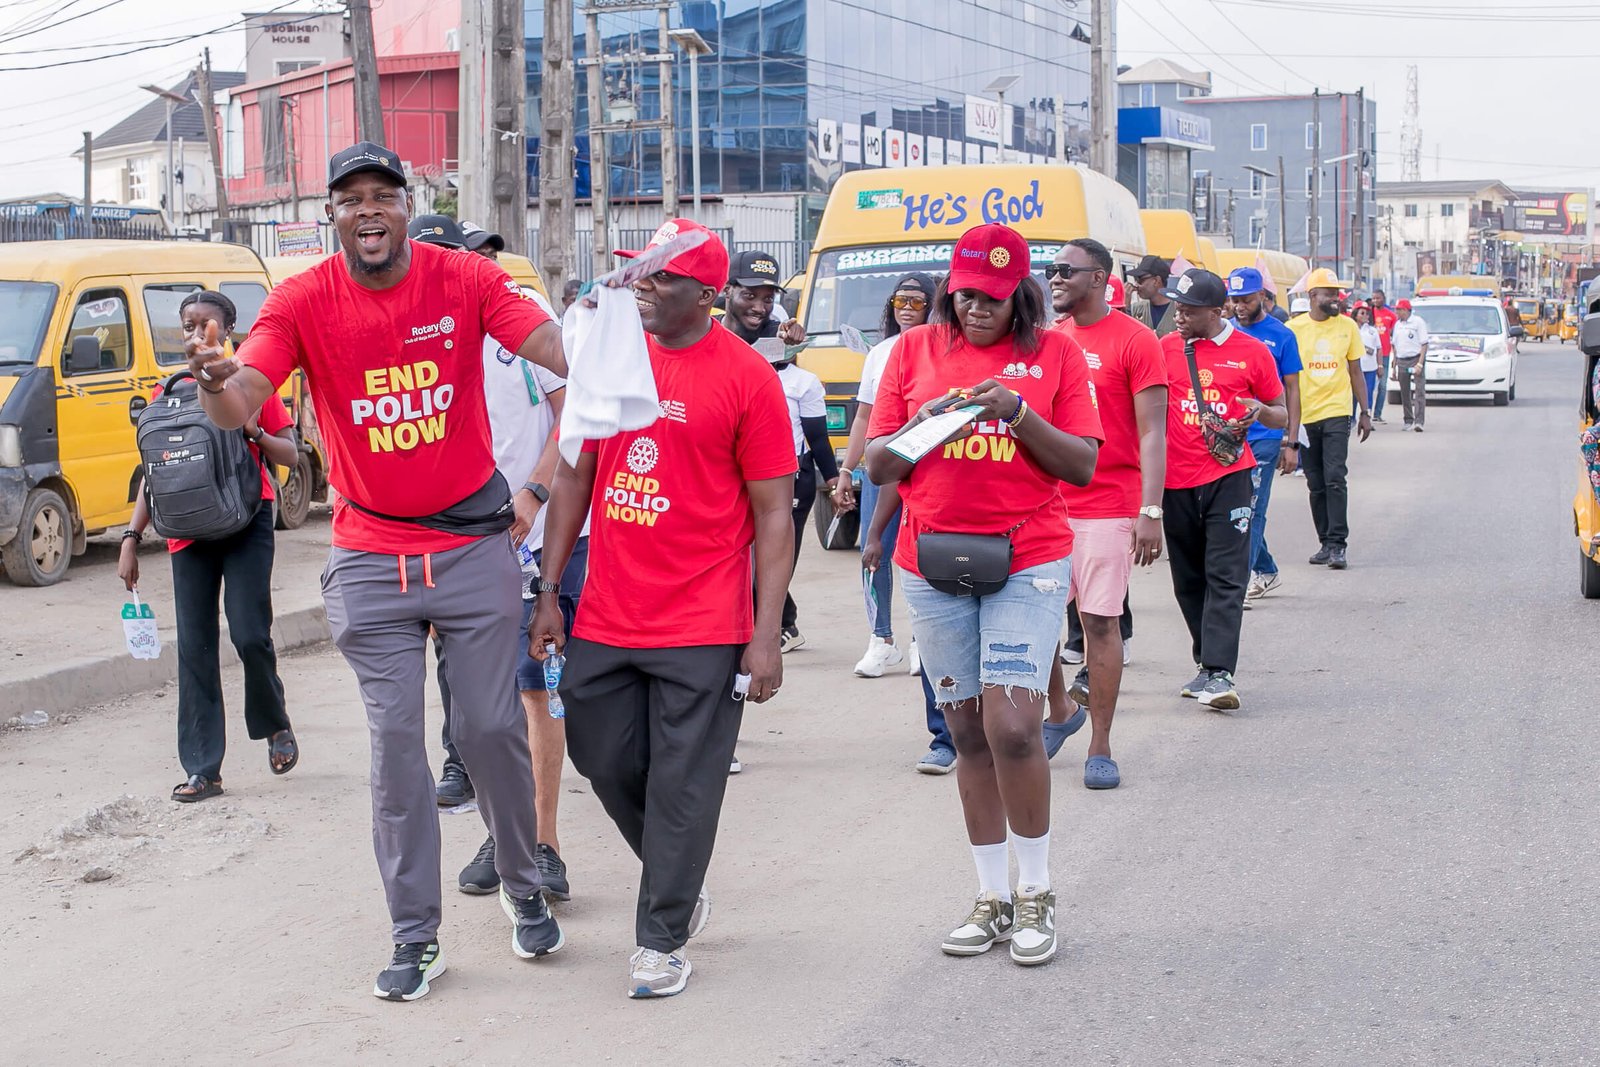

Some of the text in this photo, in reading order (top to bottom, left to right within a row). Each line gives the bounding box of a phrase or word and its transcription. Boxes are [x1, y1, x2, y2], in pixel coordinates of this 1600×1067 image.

[272, 35, 310, 43] HOUSE
[975, 103, 1000, 130] SLO
[75, 206, 131, 219] VCANIZER
[902, 179, 1045, 232] He's God
[837, 244, 953, 271] AMAZING
[960, 247, 987, 260] Rotary
[411, 323, 439, 337] Rotary
[364, 360, 439, 396] END
[1308, 361, 1339, 370] POLIO
[351, 383, 454, 425] POLIO
[1181, 399, 1227, 415] POIO
[368, 412, 447, 453] NOW
[943, 434, 1017, 463] NOW
[613, 471, 660, 495] END
[604, 486, 671, 513] POLIO
[605, 503, 659, 528] NOW
